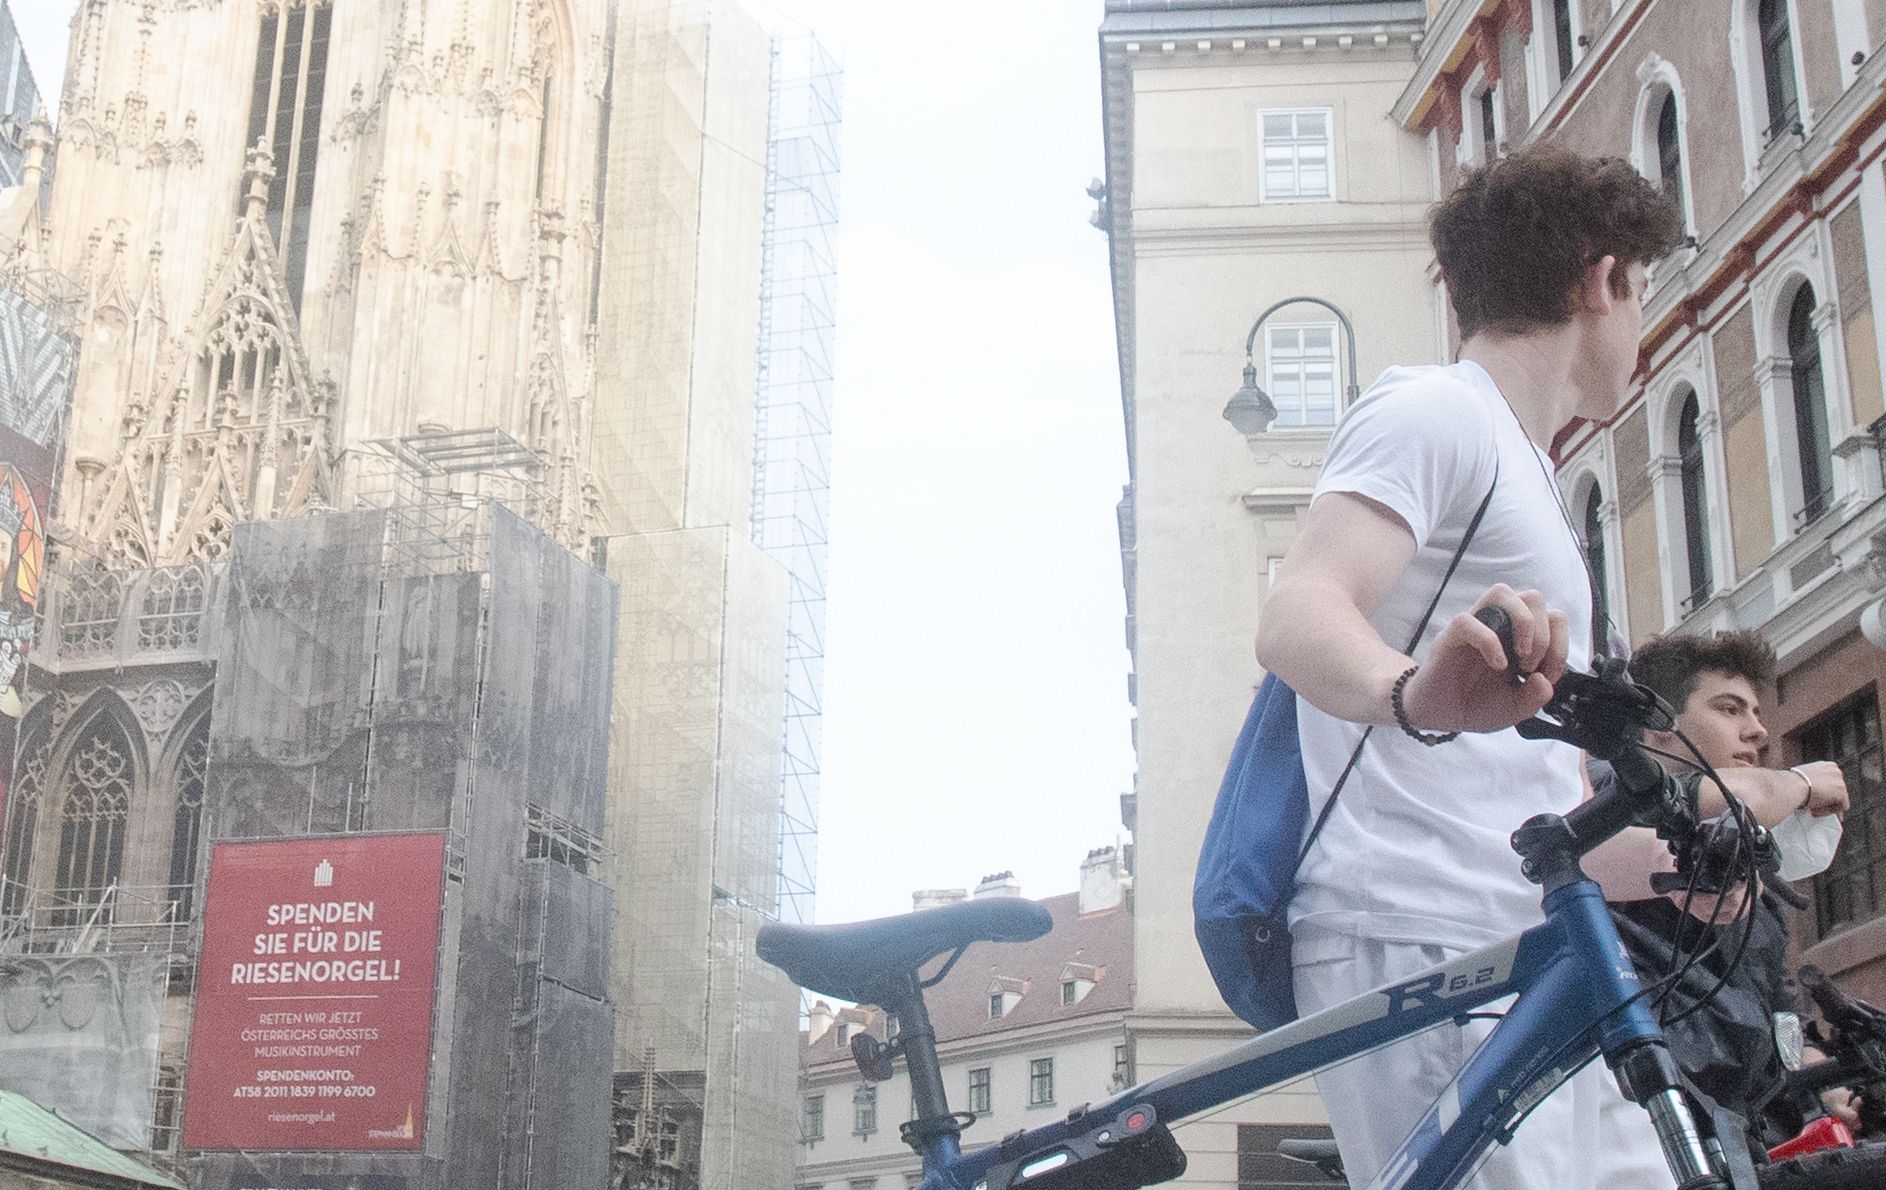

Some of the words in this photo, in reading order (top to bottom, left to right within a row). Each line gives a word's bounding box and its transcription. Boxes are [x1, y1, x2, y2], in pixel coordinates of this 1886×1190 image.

[266, 901, 375, 926] SPENDEN
[253, 932, 288, 955] SIE
[293, 925, 338, 953] FÜR
[343, 930, 383, 952] DIE
[231, 958, 401, 985] RIESENORGEL!
[259, 1012, 302, 1025] RETTEN
[304, 1012, 327, 1024] WIR
[328, 1011, 363, 1024] JETZT
[240, 1027, 317, 1042] ÖSTERREICHS
[319, 1025, 379, 1040] GRÖSSTES
[254, 1045, 362, 1058] MUSIKINSTRUMENT
[256, 1069, 355, 1082] SPENDENKONTO:
[263, 1086, 288, 1098] 2011
[267, 1109, 336, 1125] riesenorgel.at
